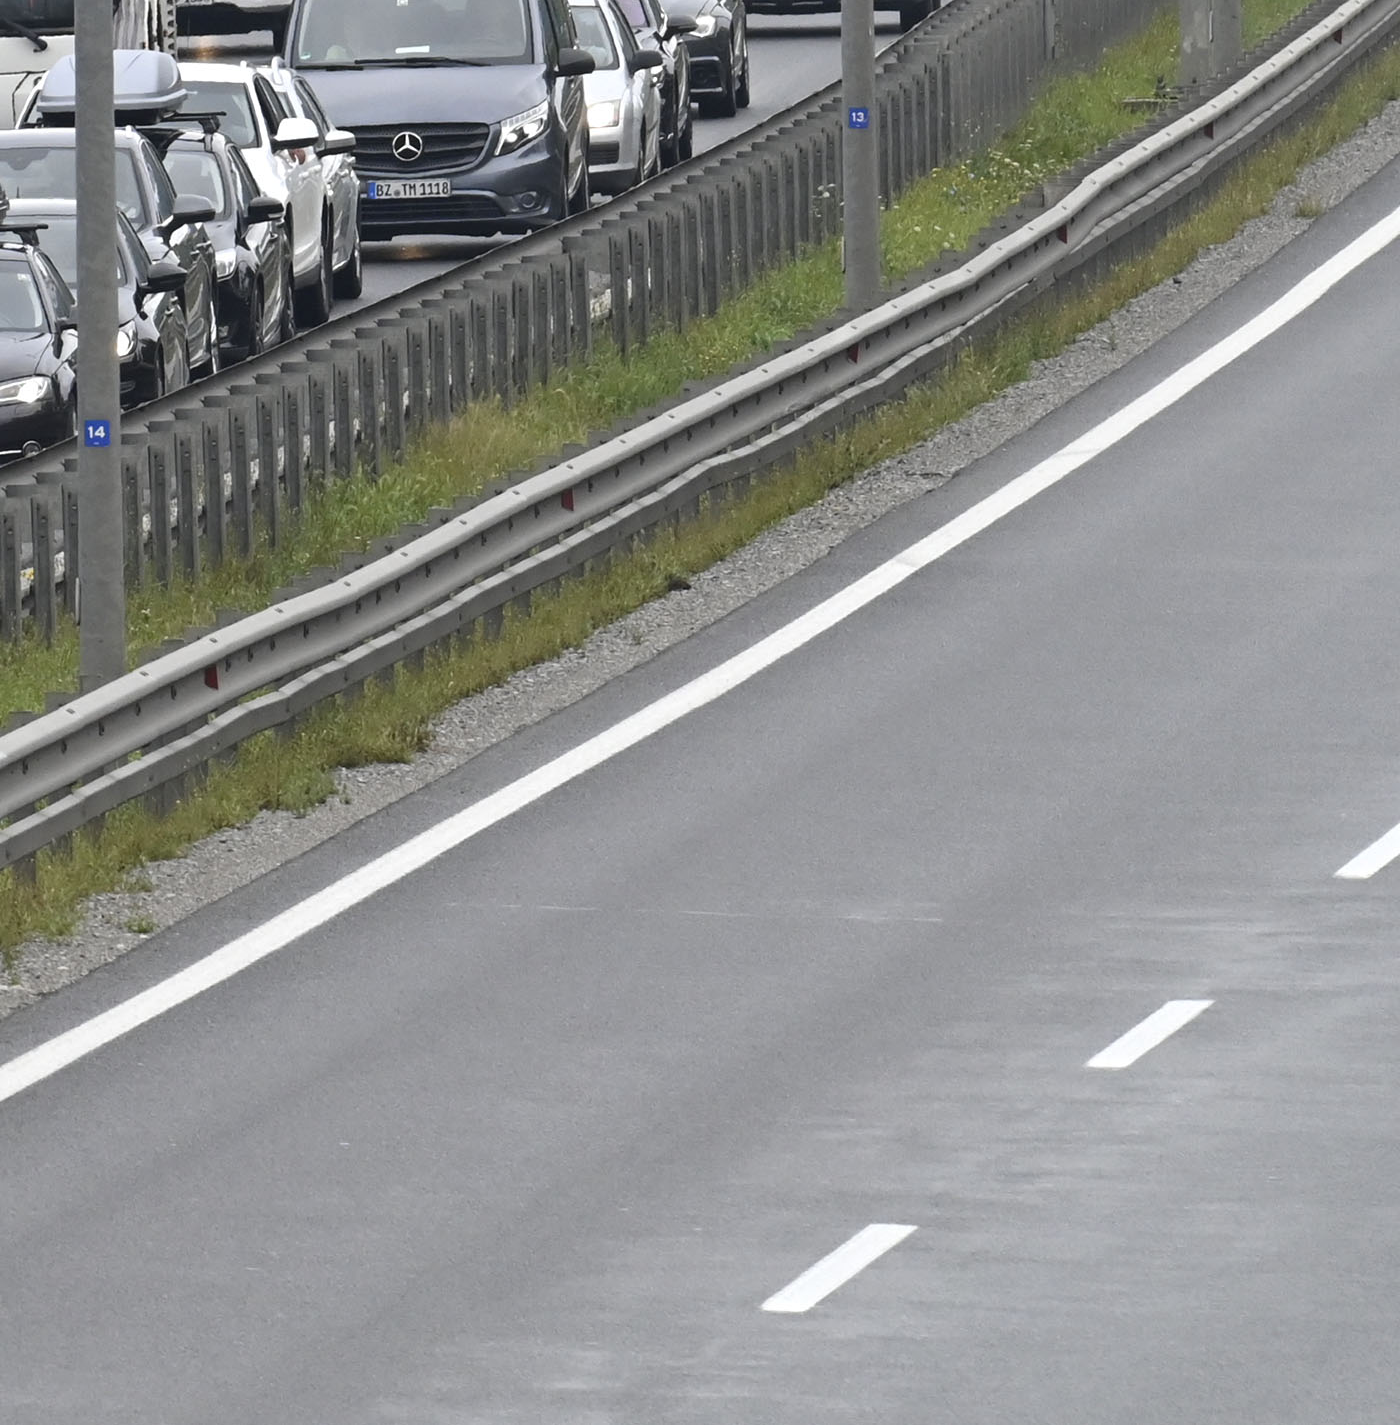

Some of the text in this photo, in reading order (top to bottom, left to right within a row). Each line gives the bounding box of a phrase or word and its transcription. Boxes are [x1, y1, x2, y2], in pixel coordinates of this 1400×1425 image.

[851, 111, 864, 122] 13
[376, 184, 391, 196] BZ
[420, 181, 449, 195] 1118
[88, 425, 105, 439] 14
